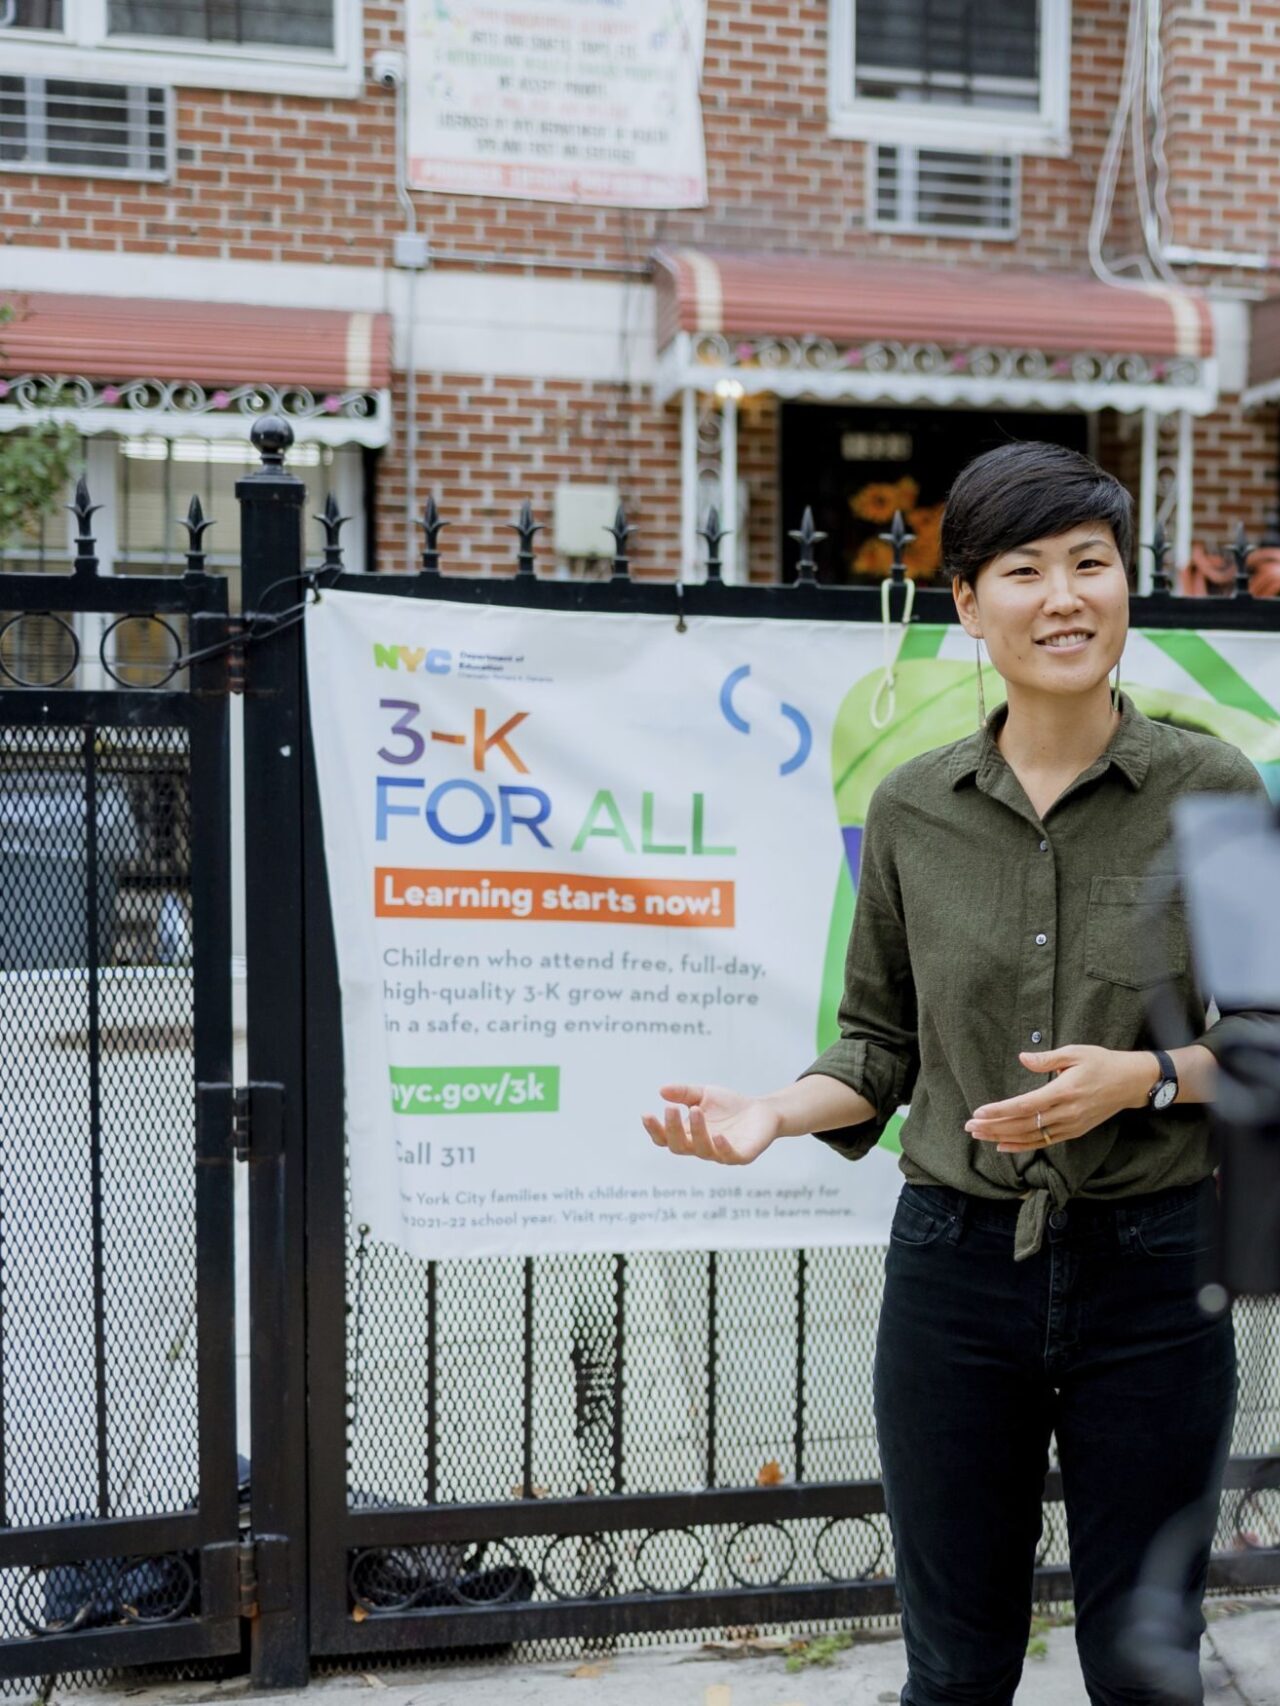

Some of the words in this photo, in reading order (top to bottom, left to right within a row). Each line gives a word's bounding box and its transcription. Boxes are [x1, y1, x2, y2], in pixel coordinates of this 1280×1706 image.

[373, 643, 451, 675] NYC
[459, 662, 504, 672] Education
[375, 776, 553, 848] FOR
[572, 789, 738, 856] ALL
[382, 875, 534, 917] Learning
[541, 884, 637, 914] starts
[643, 887, 722, 918] now!
[383, 948, 481, 968] Children
[488, 950, 533, 968] who
[540, 952, 614, 969] attend
[622, 952, 673, 974] free,
[681, 954, 765, 980] full-day,
[384, 980, 515, 1006] high-quality
[524, 982, 559, 1002] 3-K
[568, 987, 623, 1007] grow
[630, 985, 669, 1002] and
[676, 986, 758, 1009] explore
[385, 1014, 400, 1032] in
[408, 1019, 420, 1033] a
[427, 1013, 479, 1034] safe,
[487, 1015, 556, 1037] caring
[564, 1015, 711, 1036] environment.
[441, 1146, 475, 1168] 311
[417, 1192, 449, 1205] York
[455, 1191, 486, 1207] City
[491, 1189, 547, 1203] families
[553, 1187, 584, 1200] with
[588, 1186, 648, 1200] children
[652, 1186, 687, 1199] born
[691, 1186, 704, 1197] in
[710, 1186, 742, 1198] 2018
[747, 1190, 771, 1198] can
[776, 1186, 814, 1200] apply
[819, 1185, 839, 1197] for
[471, 1212, 517, 1227] school
[562, 1210, 594, 1222] Visit
[599, 1208, 677, 1225] nyc.gov/3k
[682, 1211, 697, 1220] or
[703, 1206, 726, 1219] call
[732, 1207, 750, 1220] 311
[755, 1208, 770, 1218] to
[774, 1205, 810, 1217] learn
